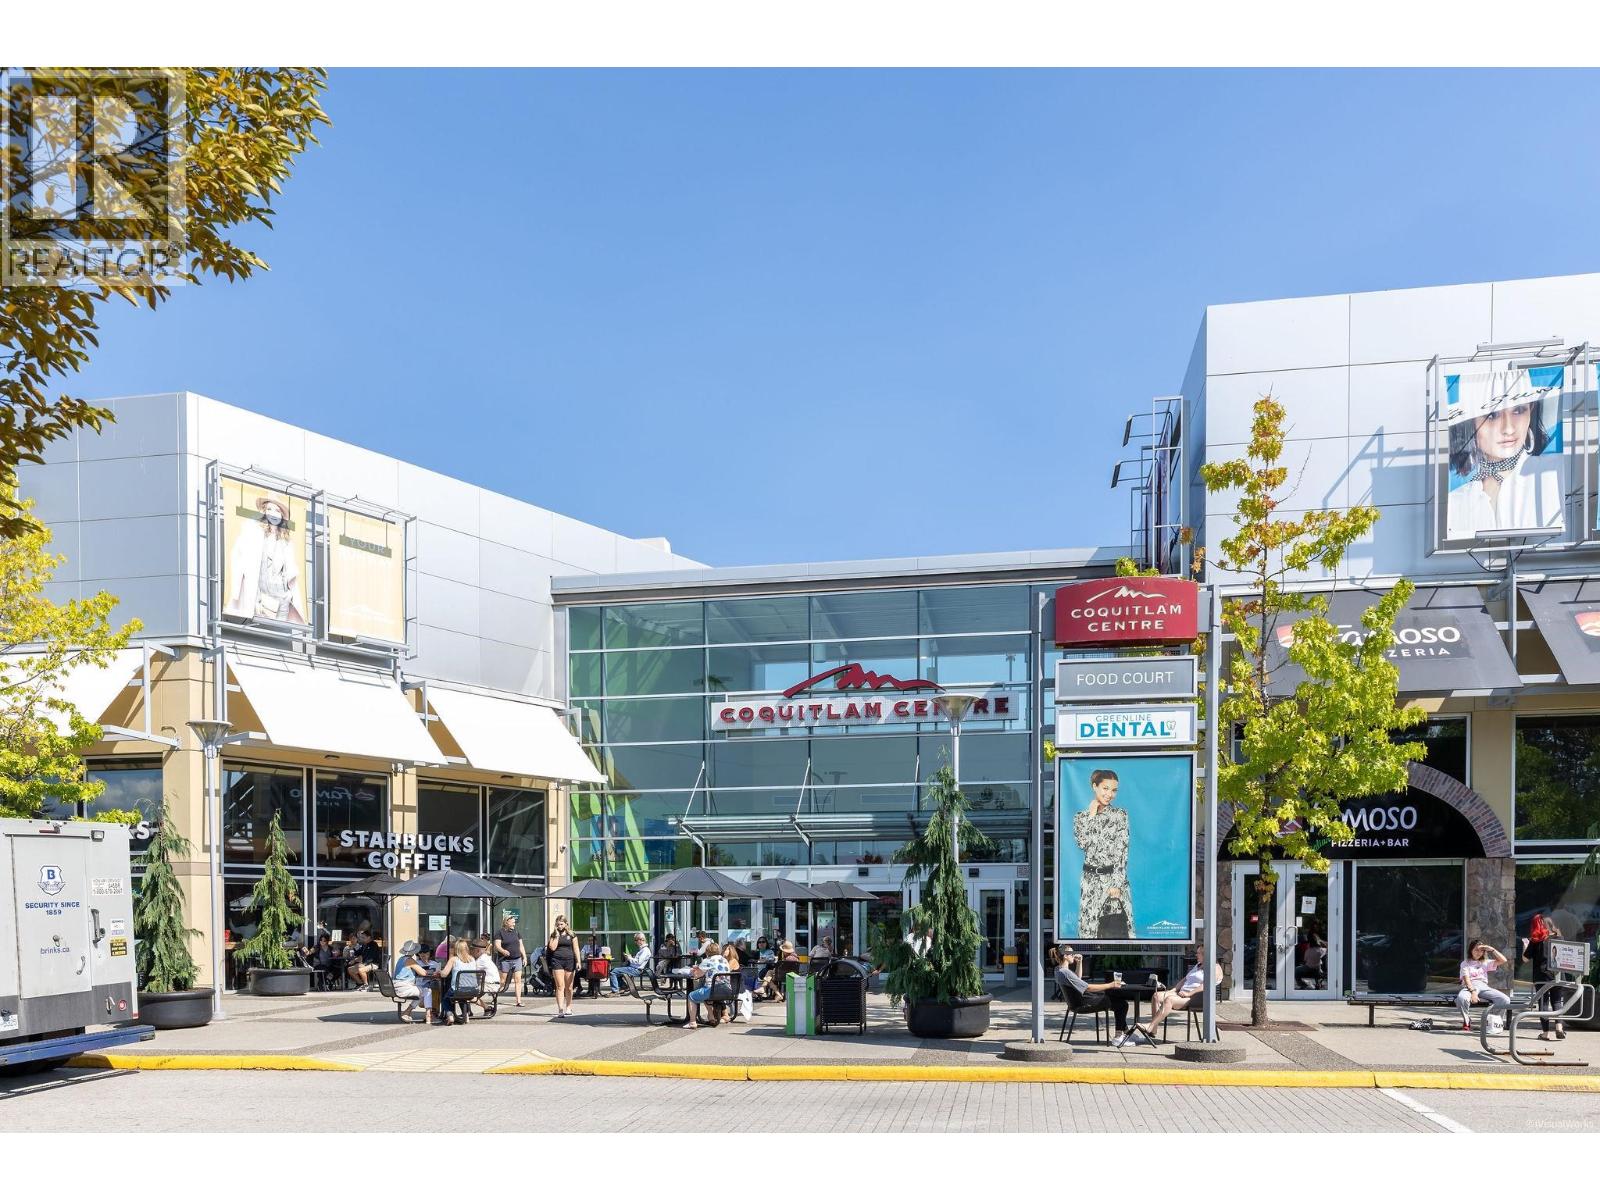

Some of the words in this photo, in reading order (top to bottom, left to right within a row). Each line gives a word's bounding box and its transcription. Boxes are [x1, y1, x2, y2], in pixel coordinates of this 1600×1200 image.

[1071, 605, 1182, 619] COQUITLAM
[1088, 620, 1165, 632] CENTRE
[1076, 673, 1118, 686] FOOD
[1122, 671, 1174, 685] COURT
[719, 702, 882, 723] COQUITLAM
[1095, 714, 1152, 722] GREENLINE
[1080, 722, 1170, 738] DENTAL
[340, 829, 475, 853] STARBUCKS
[367, 851, 451, 871] COFFEE
[47, 869, 56, 880] B
[40, 946, 70, 955] brinks.ca
